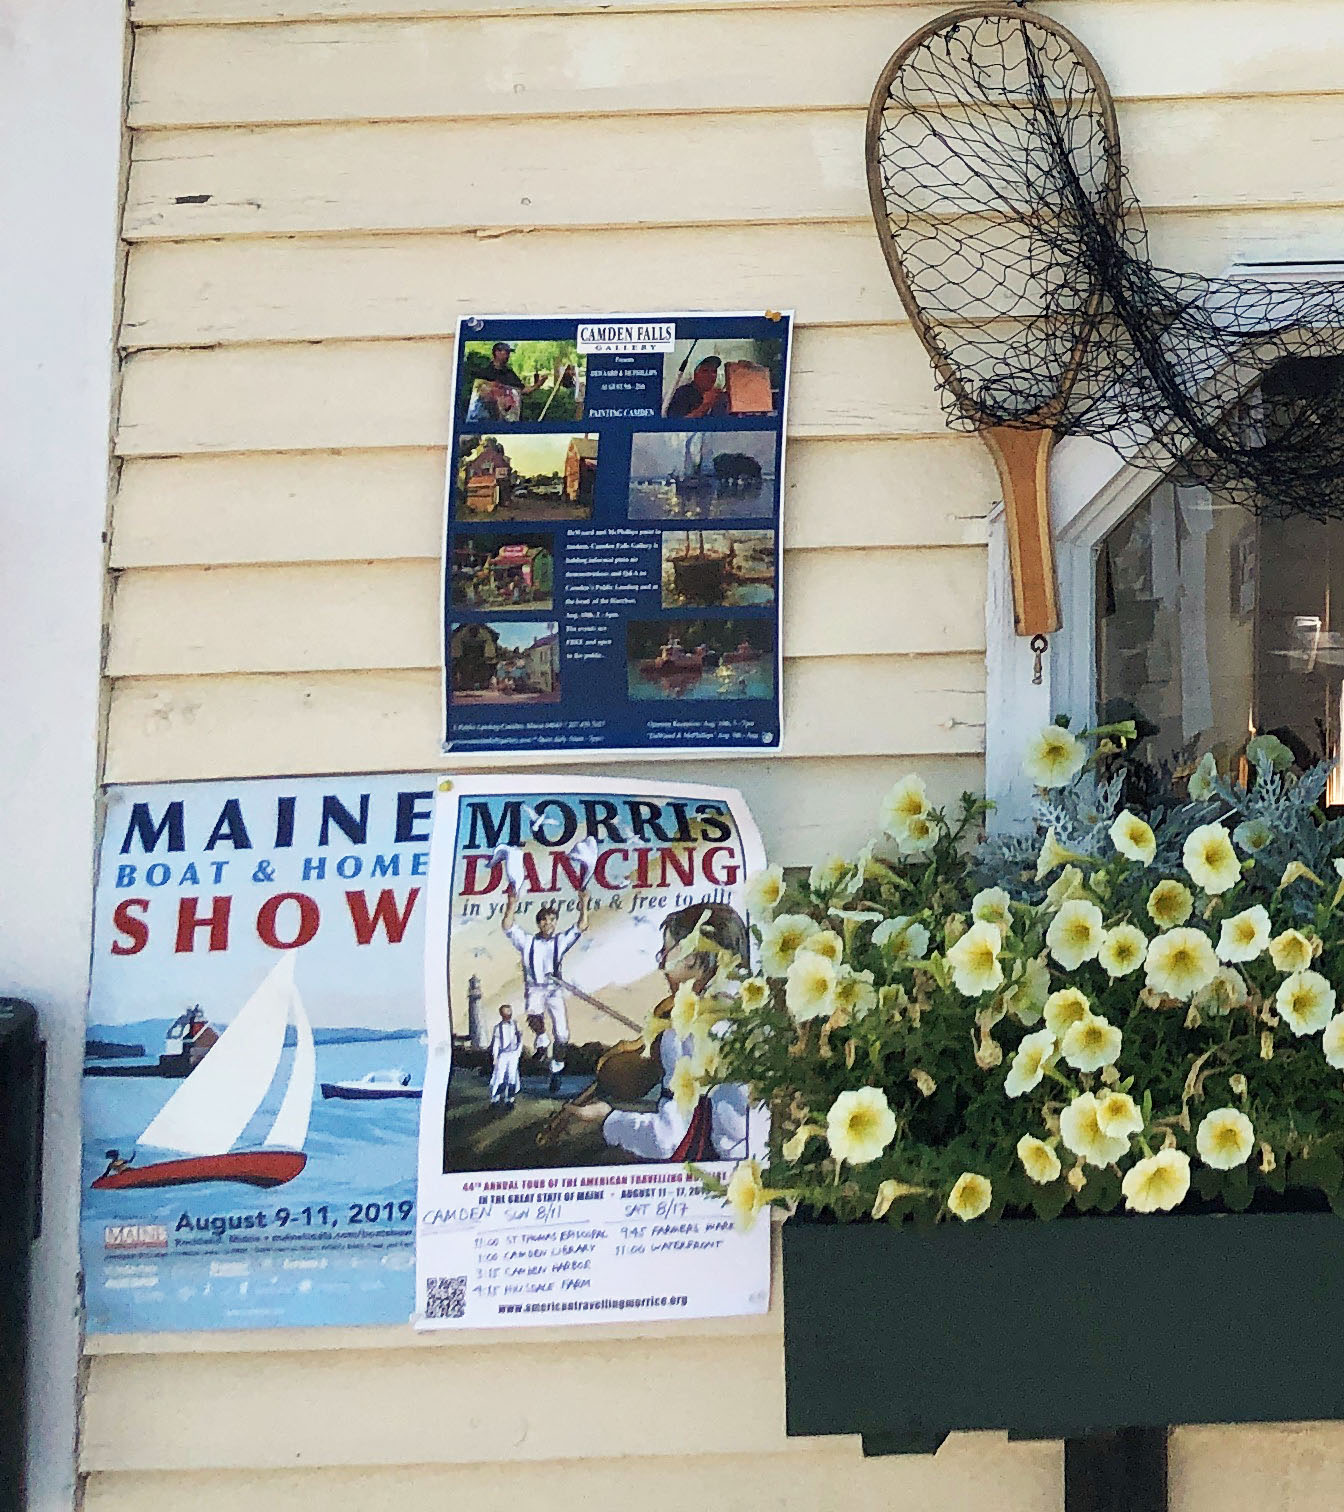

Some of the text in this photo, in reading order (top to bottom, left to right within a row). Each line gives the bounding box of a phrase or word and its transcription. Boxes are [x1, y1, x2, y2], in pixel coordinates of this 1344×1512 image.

[581, 325, 672, 341] CAMDEN FALLS
[623, 409, 655, 417] CAMDEN
[119, 790, 434, 855] MAINE
[462, 799, 732, 850] MORRIS
[115, 852, 430, 888] BOAT & HOME
[459, 846, 740, 896] DANCING
[628, 891, 667, 913] free
[110, 886, 422, 956] SHOW
[483, 1180, 518, 1191] ANNUAL
[522, 1179, 545, 1189] TOUR
[549, 1178, 558, 1188] OF
[562, 1177, 577, 1188] THE
[580, 1174, 627, 1187] AMERICAN
[478, 1195, 488, 1205] IN
[490, 1194, 505, 1204] THE
[508, 1193, 534, 1204] GREAT
[536, 1191, 561, 1203] STATE
[564, 1191, 574, 1201] OF
[576, 1190, 604, 1201] MAINE
[621, 1187, 655, 1199] AUGUST
[175, 1199, 414, 1235] August 9-11, 2019
[422, 1206, 492, 1225] CAMDEN
[536, 1204, 562, 1224] 8/11
[625, 1198, 688, 1220] SAT 8/17
[651, 1223, 699, 1237] FARMERS
